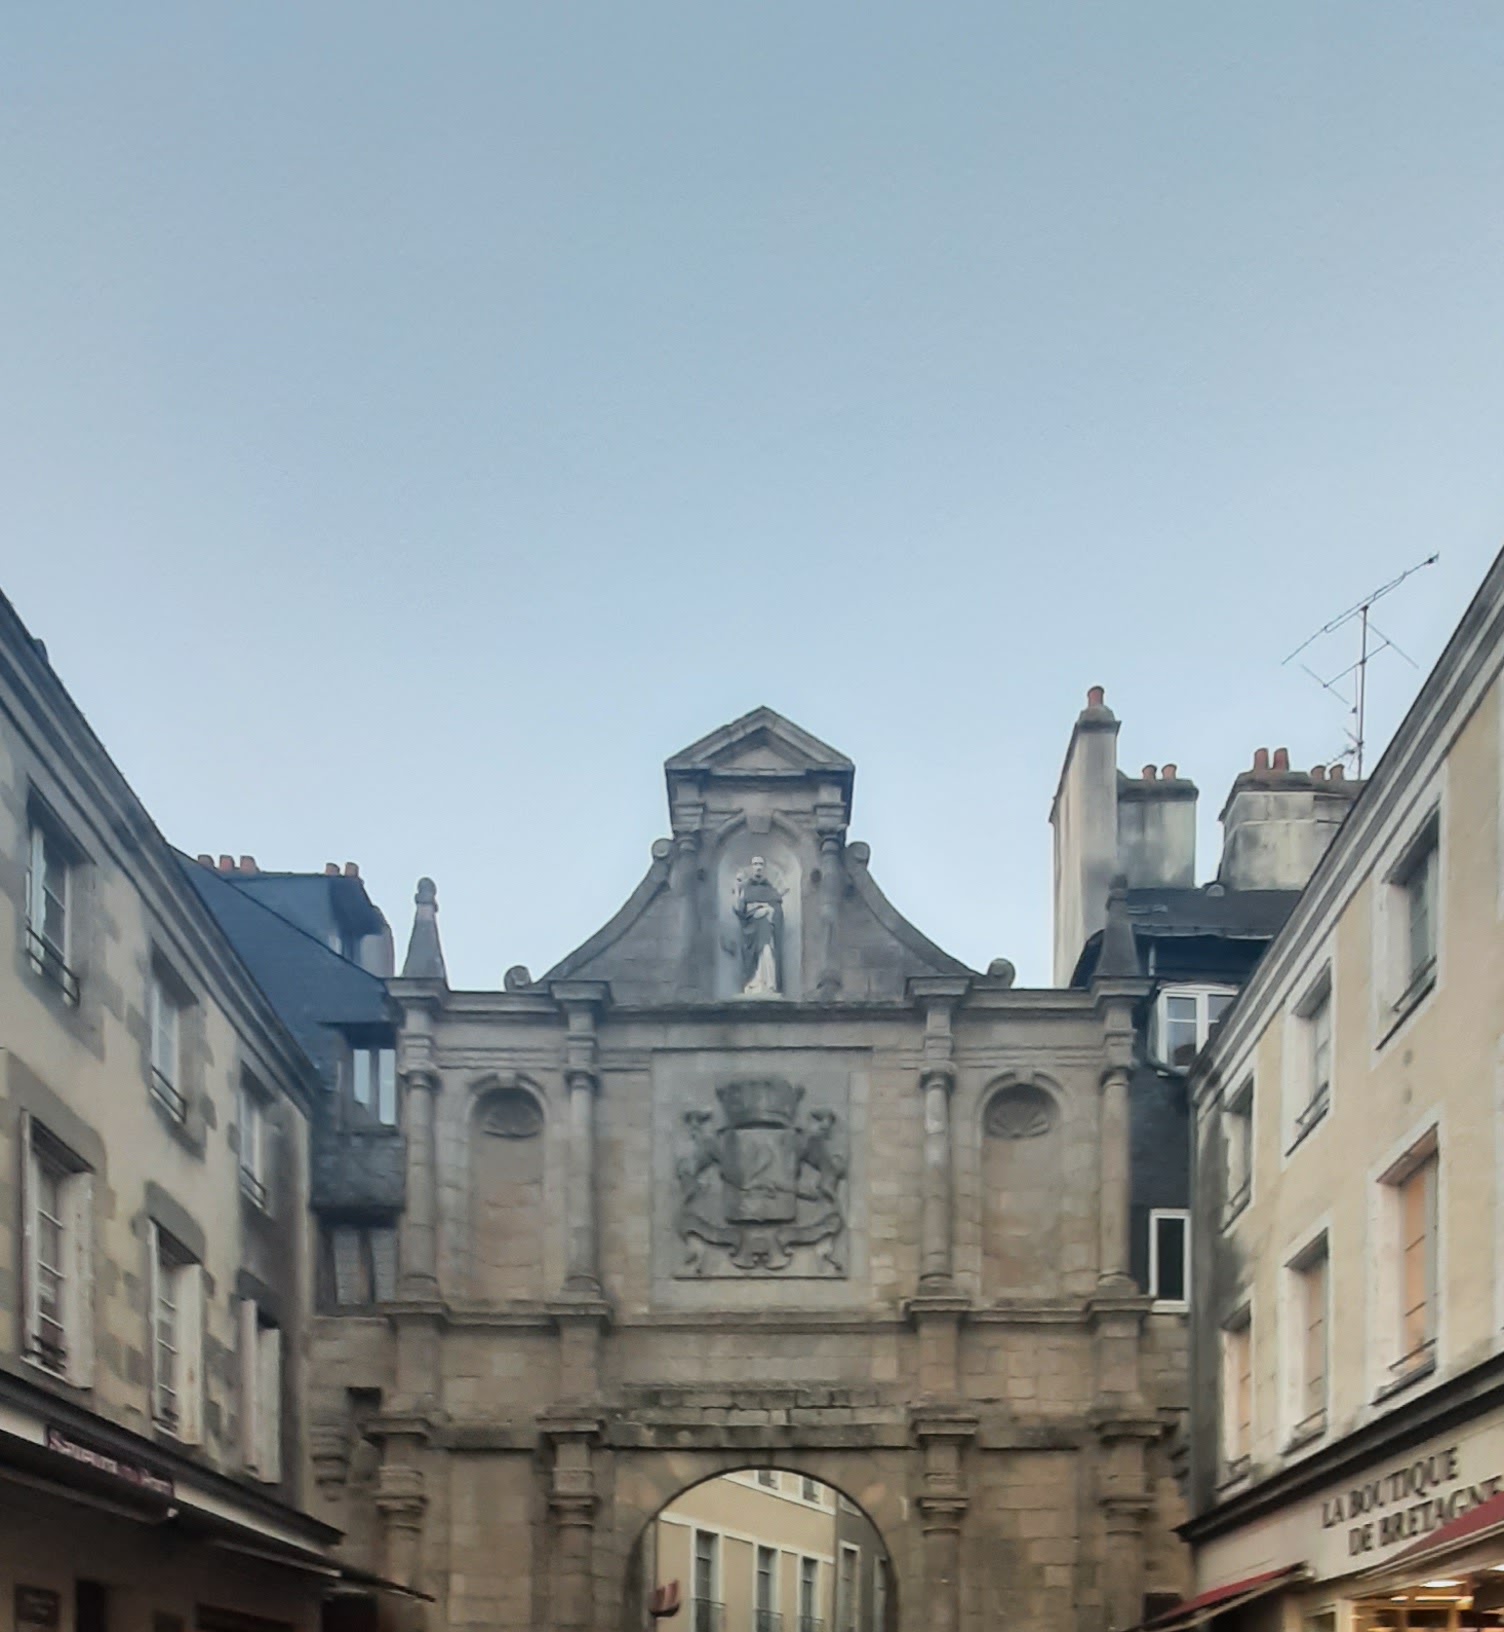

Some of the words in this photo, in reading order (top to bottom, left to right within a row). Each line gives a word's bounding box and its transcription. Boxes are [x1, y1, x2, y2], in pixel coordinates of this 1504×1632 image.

[1322, 1498, 1343, 1528] LA
[1348, 1446, 1457, 1518] BOUTIQUE
[1349, 1523, 1373, 1556] DE
